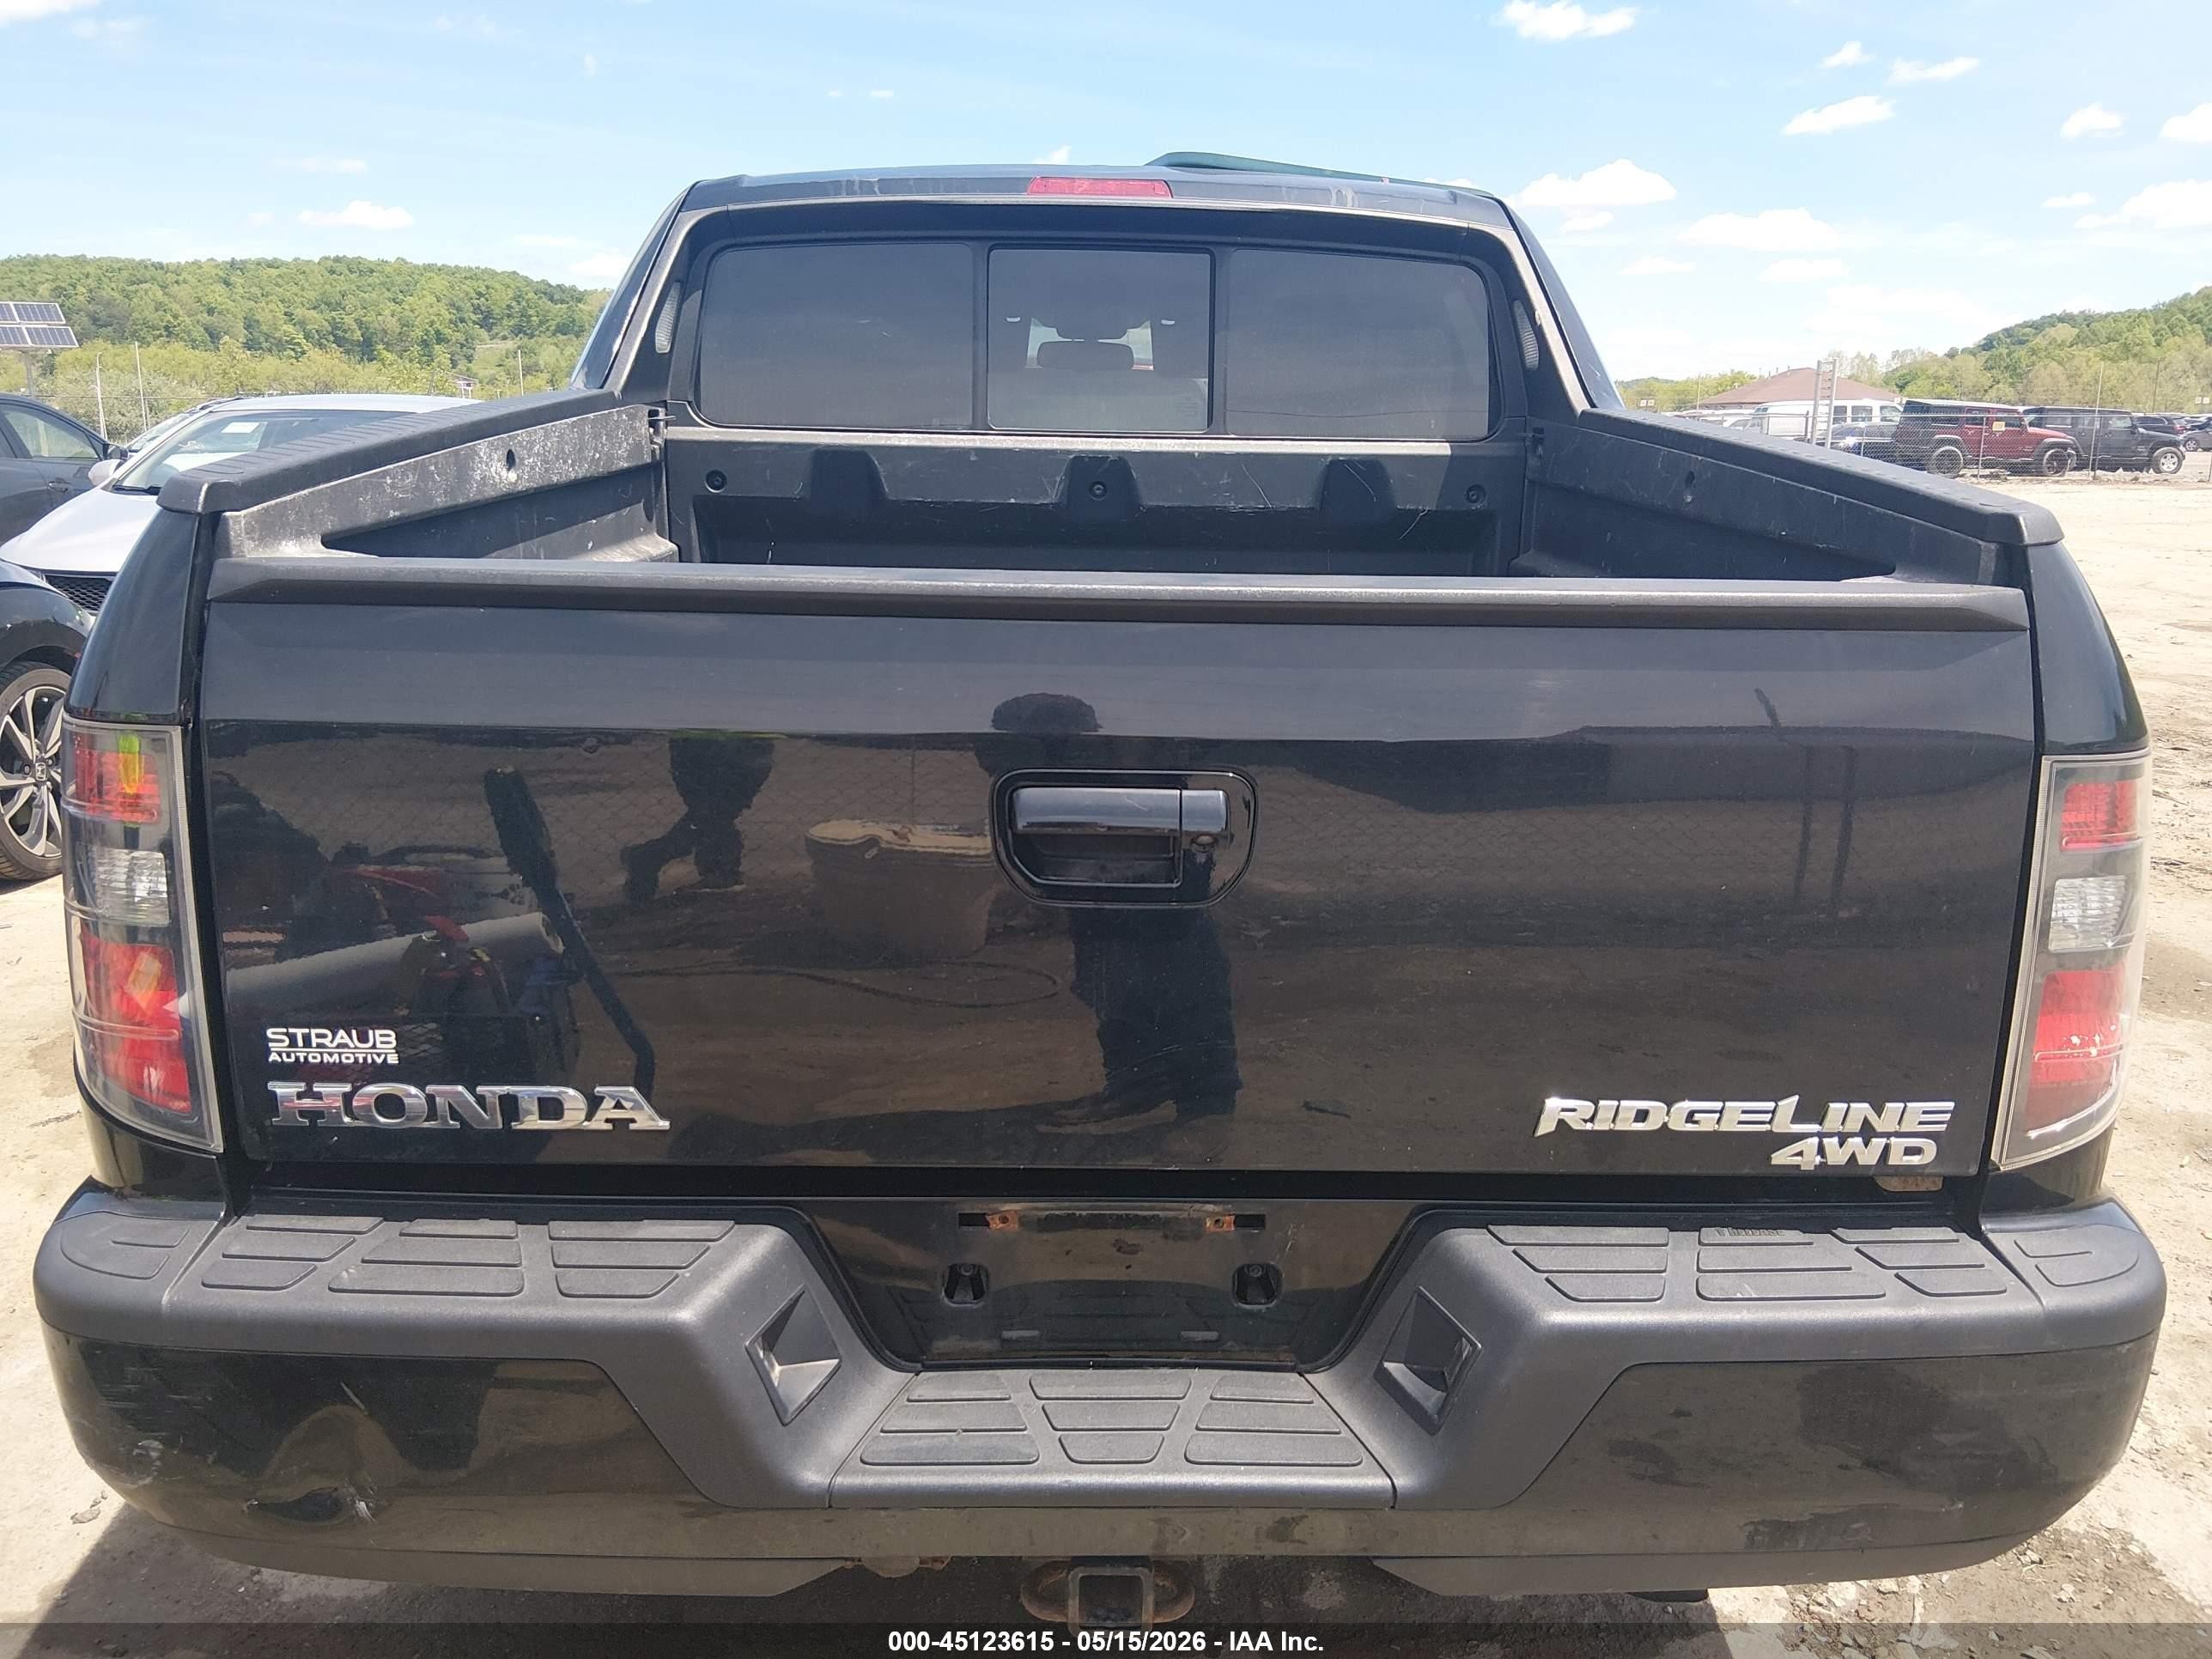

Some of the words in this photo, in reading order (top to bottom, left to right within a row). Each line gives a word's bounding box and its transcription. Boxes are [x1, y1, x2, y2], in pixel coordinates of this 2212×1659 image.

[266, 1028, 397, 1048] STRAUB
[268, 1052, 399, 1064] AUTOMOTIVE
[267, 1081, 672, 1130] HONDA
[1771, 1136, 1938, 1170] 4WD
